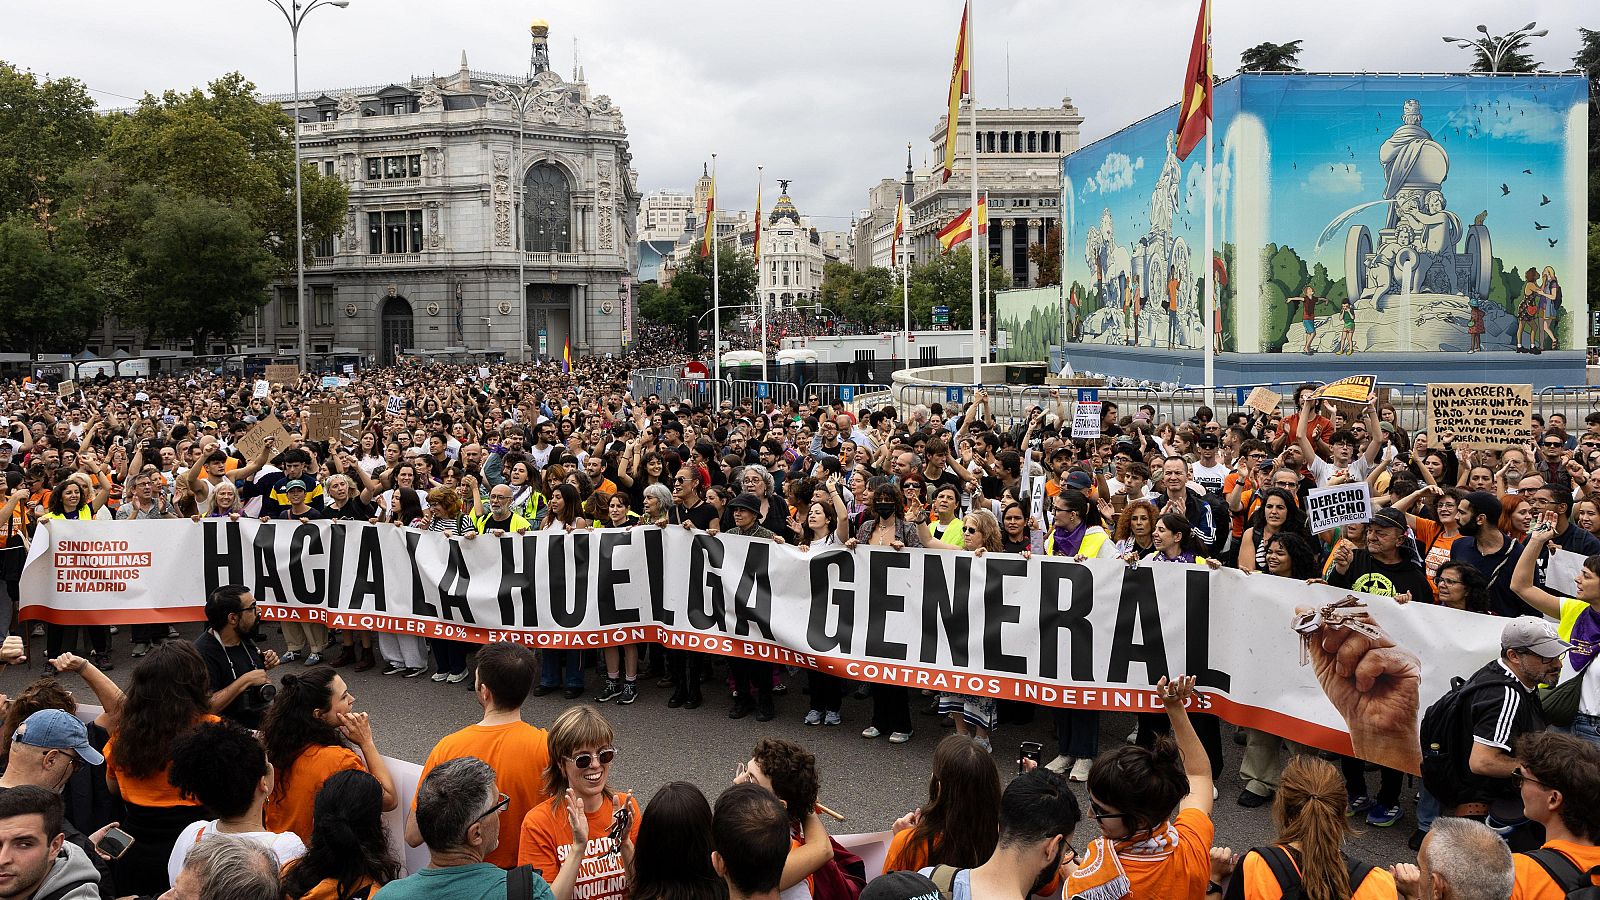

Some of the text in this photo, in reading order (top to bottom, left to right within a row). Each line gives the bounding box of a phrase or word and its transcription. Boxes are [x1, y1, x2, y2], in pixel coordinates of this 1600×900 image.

[1432, 387, 1456, 397] UNA
[1433, 399, 1449, 408] UN
[1490, 399, 1505, 407] UN
[1467, 408, 1474, 416] Y
[1475, 407, 1488, 416] LA
[1435, 418, 1523, 427] FORMA DE TENER
[1434, 426, 1455, 434] UNA
[1514, 429, 1531, 437] QUE
[1500, 437, 1531, 445] MADRE
[1310, 489, 1364, 509] DERECHO
[1312, 501, 1366, 522] A TECHO
[1319, 517, 1339, 527] JUSTO
[1340, 513, 1367, 522] PRECIO!
[58, 541, 129, 552] SINDICATO
[57, 554, 149, 567] DE INQUILINAS
[57, 568, 140, 581] E INQUILINOS
[56, 581, 127, 592] DE MADRID
[203, 521, 1231, 693] HACIA LA HUELGA GENERAL
[332, 614, 426, 635] ALQUILER
[434, 624, 467, 639] 50%
[488, 625, 646, 648] EXPROPIACIÓN
[656, 629, 734, 653] FONDOS
[743, 643, 817, 669] BUITRE
[846, 662, 1002, 695] CONTRATOS
